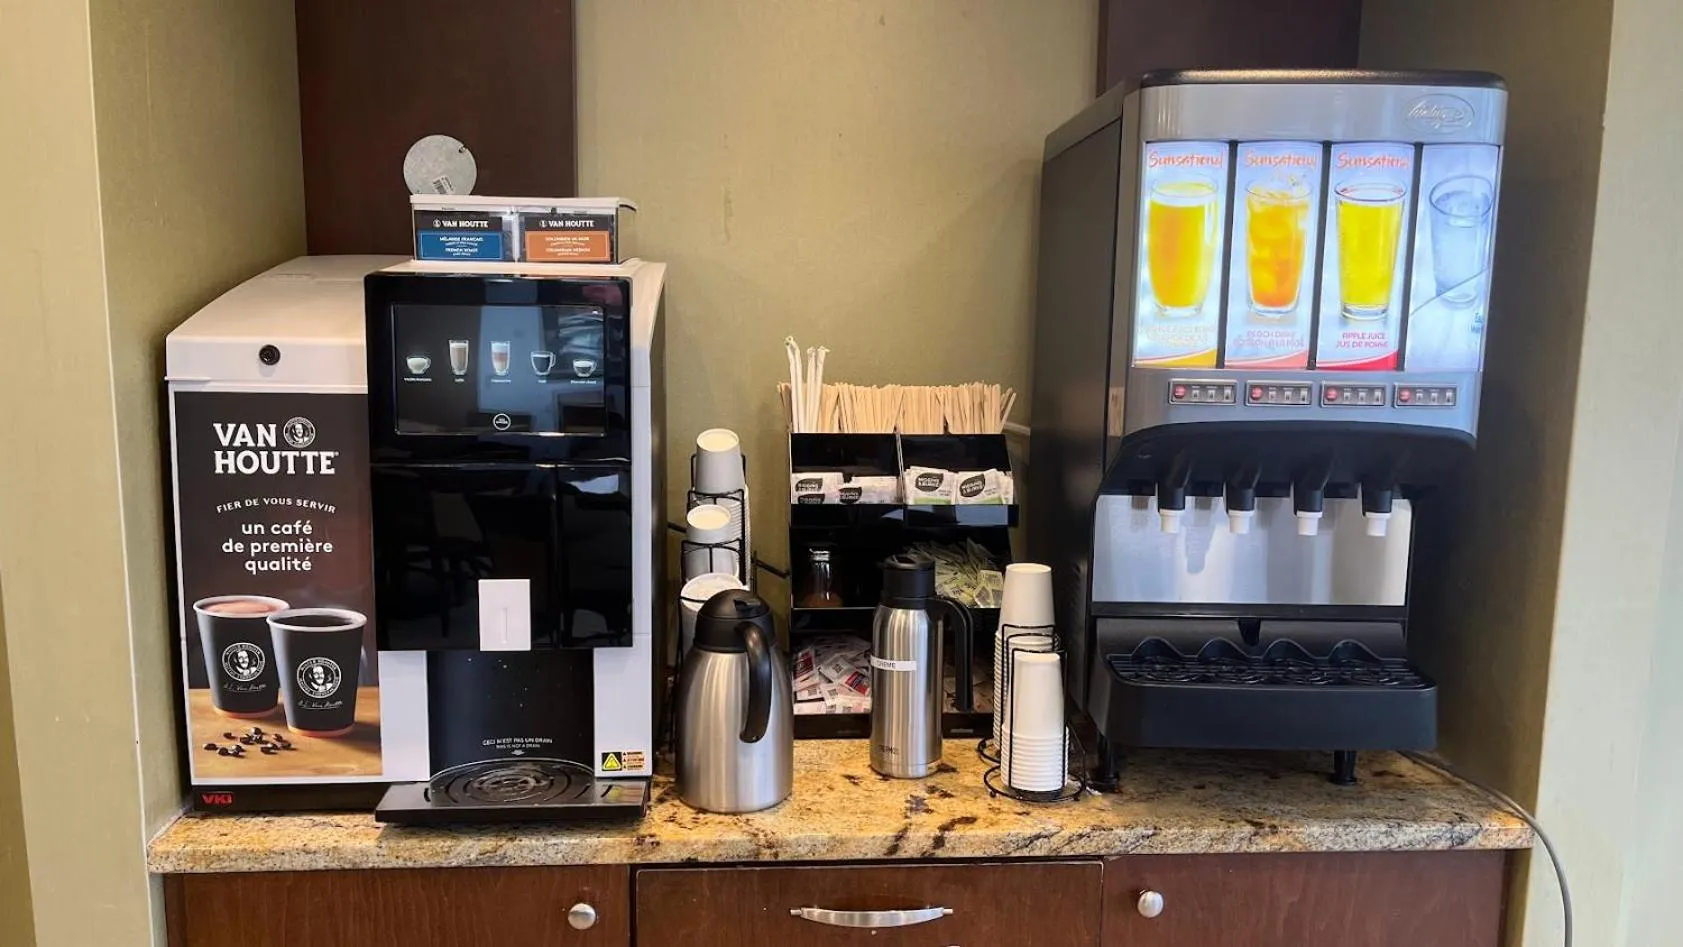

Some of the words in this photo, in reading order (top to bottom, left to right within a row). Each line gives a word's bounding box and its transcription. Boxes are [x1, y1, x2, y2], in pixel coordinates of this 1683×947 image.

[442, 220, 458, 228] VAN
[459, 220, 489, 228] HOUTTE
[548, 220, 564, 228] VAN
[565, 220, 595, 228] HOUTTE
[1342, 332, 1365, 340] APPLE
[1366, 332, 1386, 340] JUICE
[213, 423, 277, 448] VAN
[214, 450, 336, 475] HOUTTE
[216, 501, 242, 514] FIER
[245, 498, 260, 507] DE
[263, 497, 293, 506] VOUS
[296, 499, 337, 514] SERVIR
[242, 524, 265, 534] un
[271, 520, 313, 535] café
[221, 538, 244, 553] de
[250, 538, 333, 557] première
[245, 556, 312, 575] qualité
